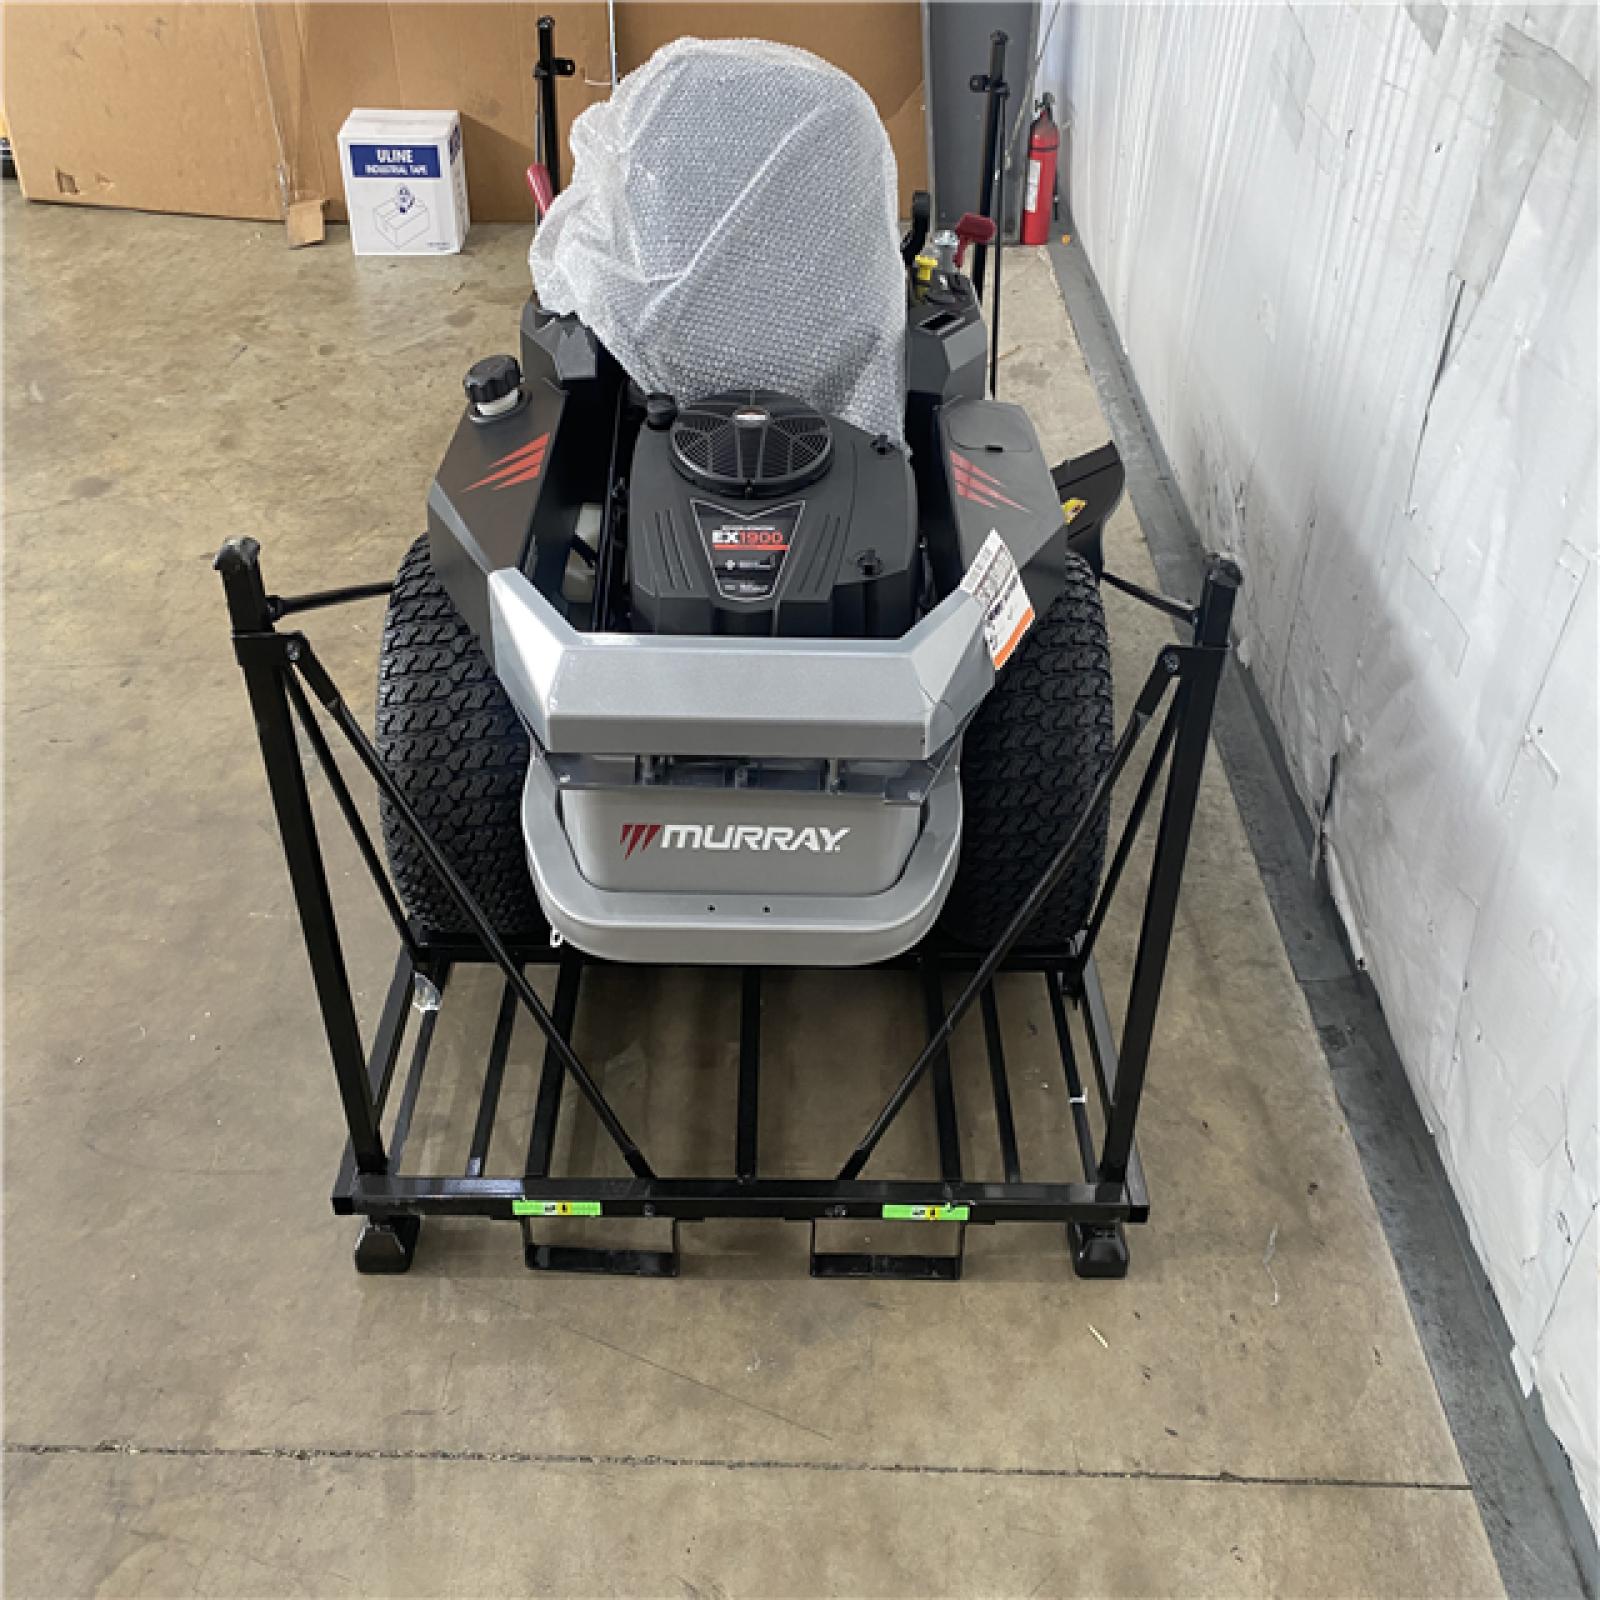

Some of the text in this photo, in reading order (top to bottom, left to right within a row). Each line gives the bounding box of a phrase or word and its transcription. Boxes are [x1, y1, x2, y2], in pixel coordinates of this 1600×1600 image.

[376, 149, 413, 163] ULINE
[365, 164, 428, 176] INDUSTRIAL TAPE
[711, 529, 783, 545] EX1900
[660, 824, 850, 853] MURRAY
